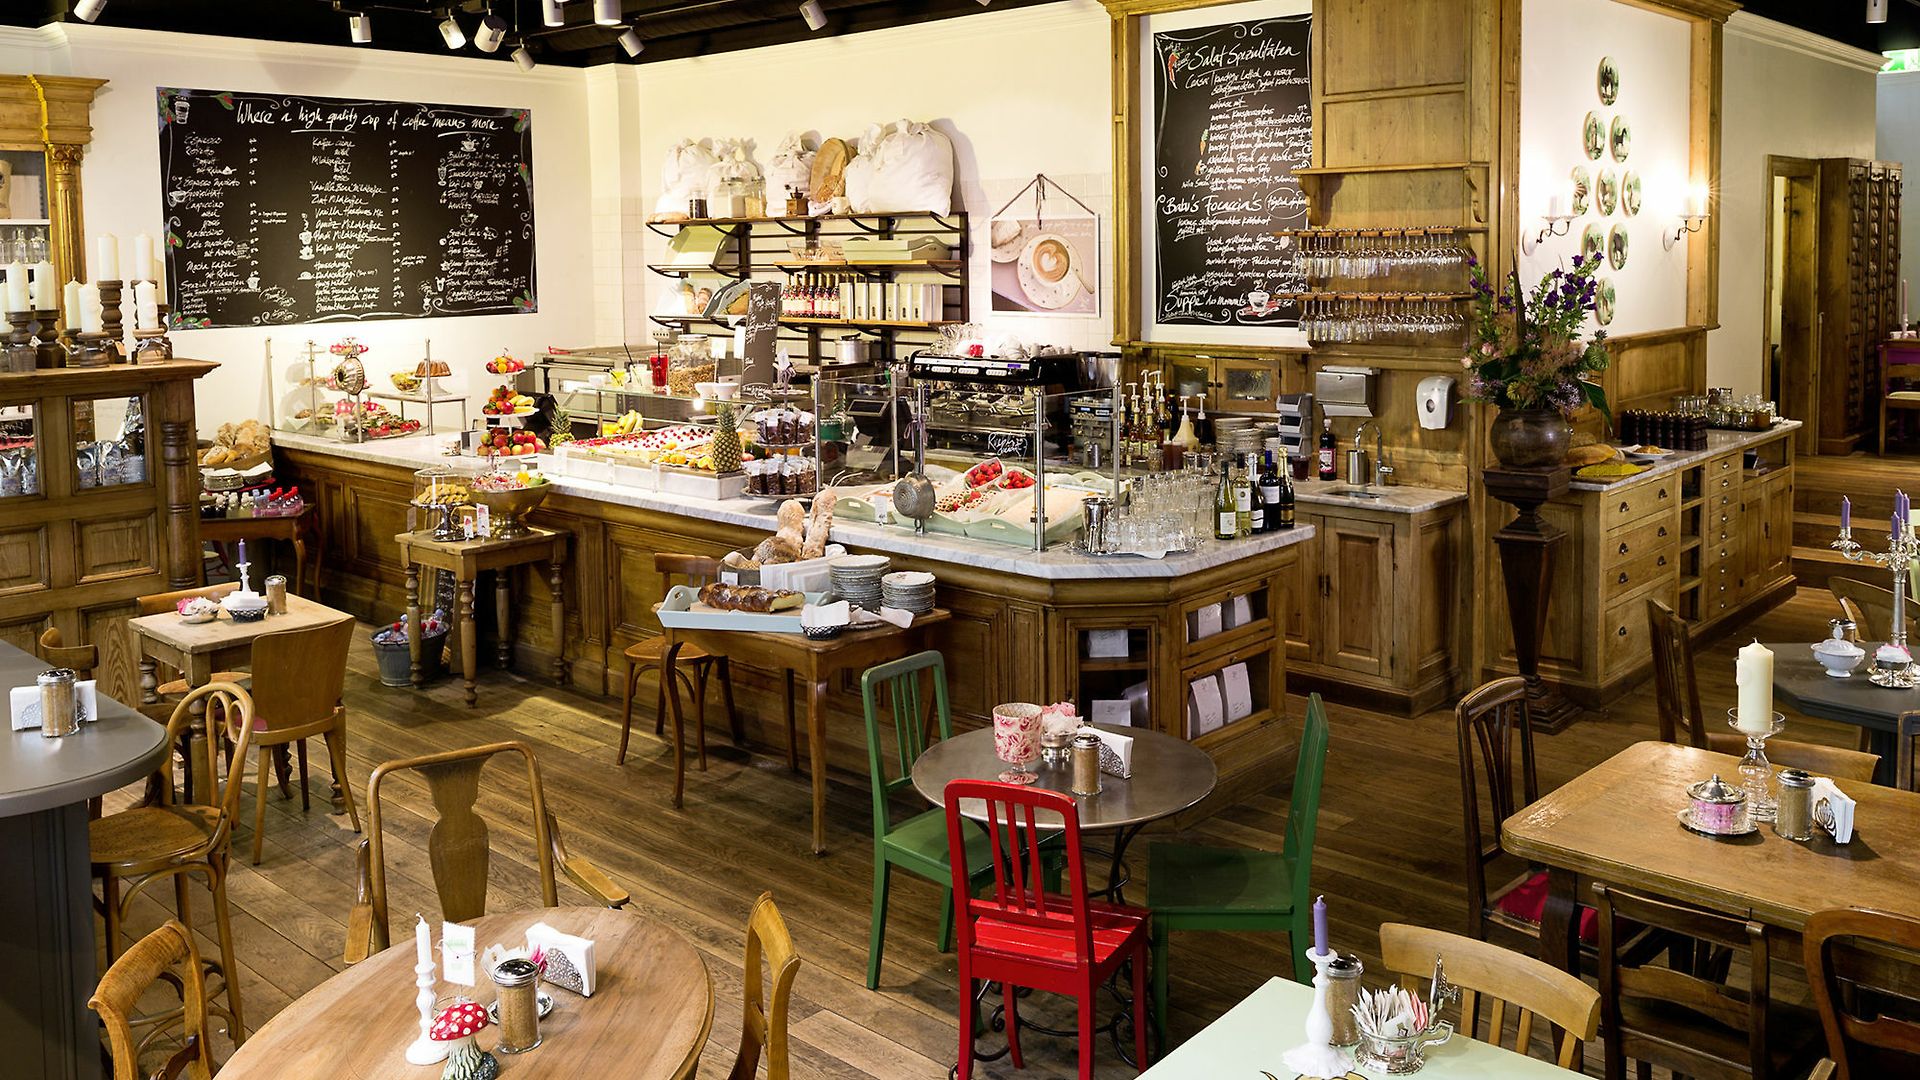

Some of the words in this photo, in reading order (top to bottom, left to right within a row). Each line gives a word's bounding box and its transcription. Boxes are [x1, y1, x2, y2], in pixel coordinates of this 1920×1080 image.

[1188, 45, 1228, 70] Salat
[1227, 38, 1301, 66] Spezialitäten
[237, 101, 275, 124] Where
[299, 106, 323, 129] high
[326, 107, 358, 132] quality
[361, 115, 380, 131] cup
[387, 109, 399, 130] of
[402, 111, 429, 130] coffee
[432, 117, 466, 128] means
[1163, 194, 1200, 215] Babu's
[1202, 191, 1262, 216] Focaccia's
[1165, 287, 1205, 313] Suppe
